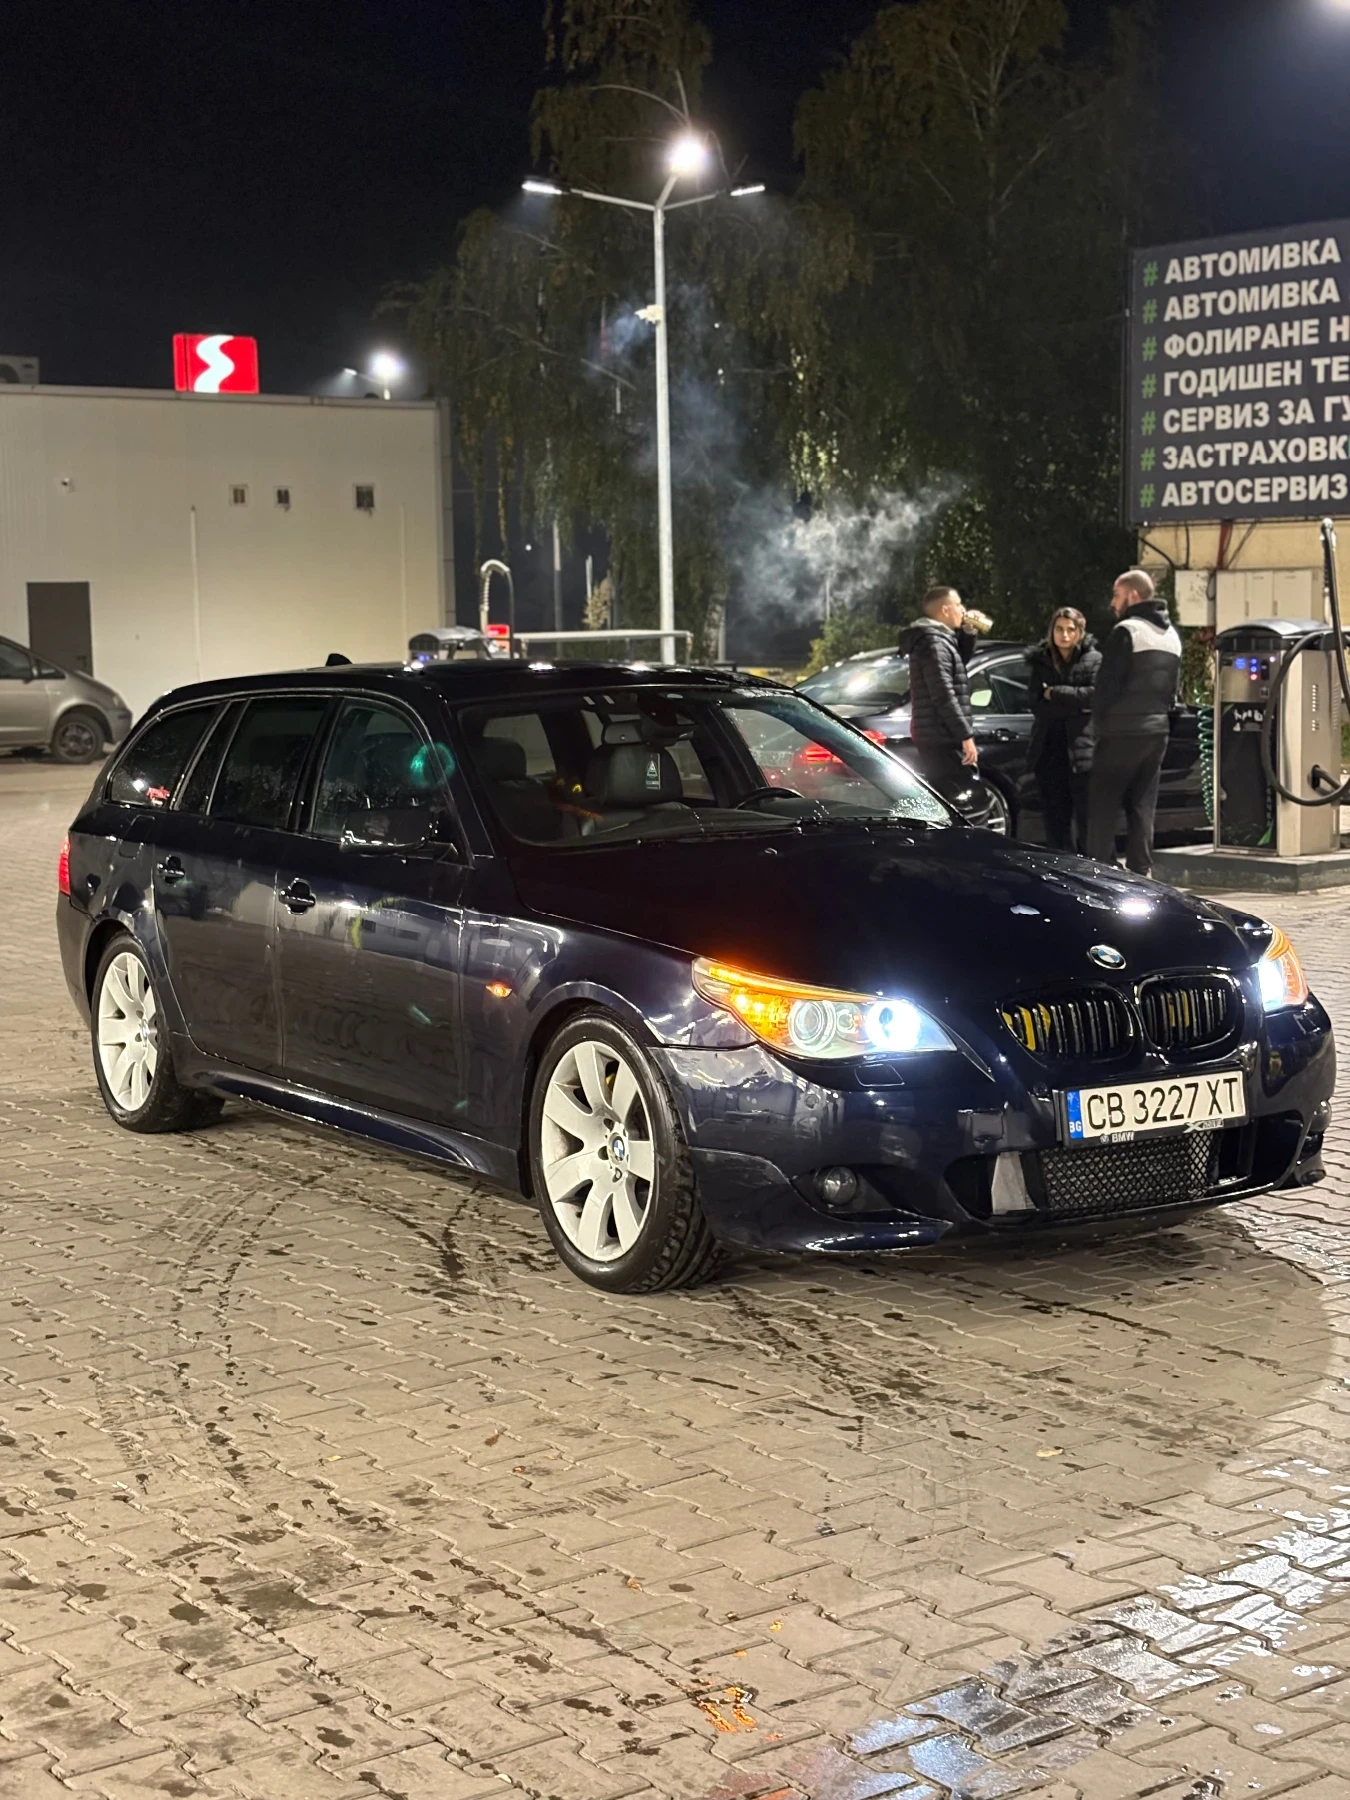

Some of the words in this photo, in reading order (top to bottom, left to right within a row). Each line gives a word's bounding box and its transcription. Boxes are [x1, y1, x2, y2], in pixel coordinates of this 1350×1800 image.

[1164, 238, 1341, 284] АВТОМИВКА
[1164, 277, 1340, 322] АВТОМИВКА
[1164, 318, 1319, 358] ФОЛИРАНЕ
[1164, 359, 1302, 398] ГОДИШЕН
[1311, 356, 1350, 383] ТЕ
[1163, 402, 1270, 434] СЕРВИЗ
[1278, 398, 1315, 426] ЗА
[1162, 435, 1350, 470] ЗАСТРАХОВК
[1161, 473, 1347, 507] АВТОСЕРВИЗ
[1087, 1092, 1125, 1130] CB
[1133, 1082, 1199, 1125] 3227
[1207, 1077, 1238, 1116] XT
[1069, 1121, 1082, 1133] BG
[1111, 1131, 1135, 1143] BMW
